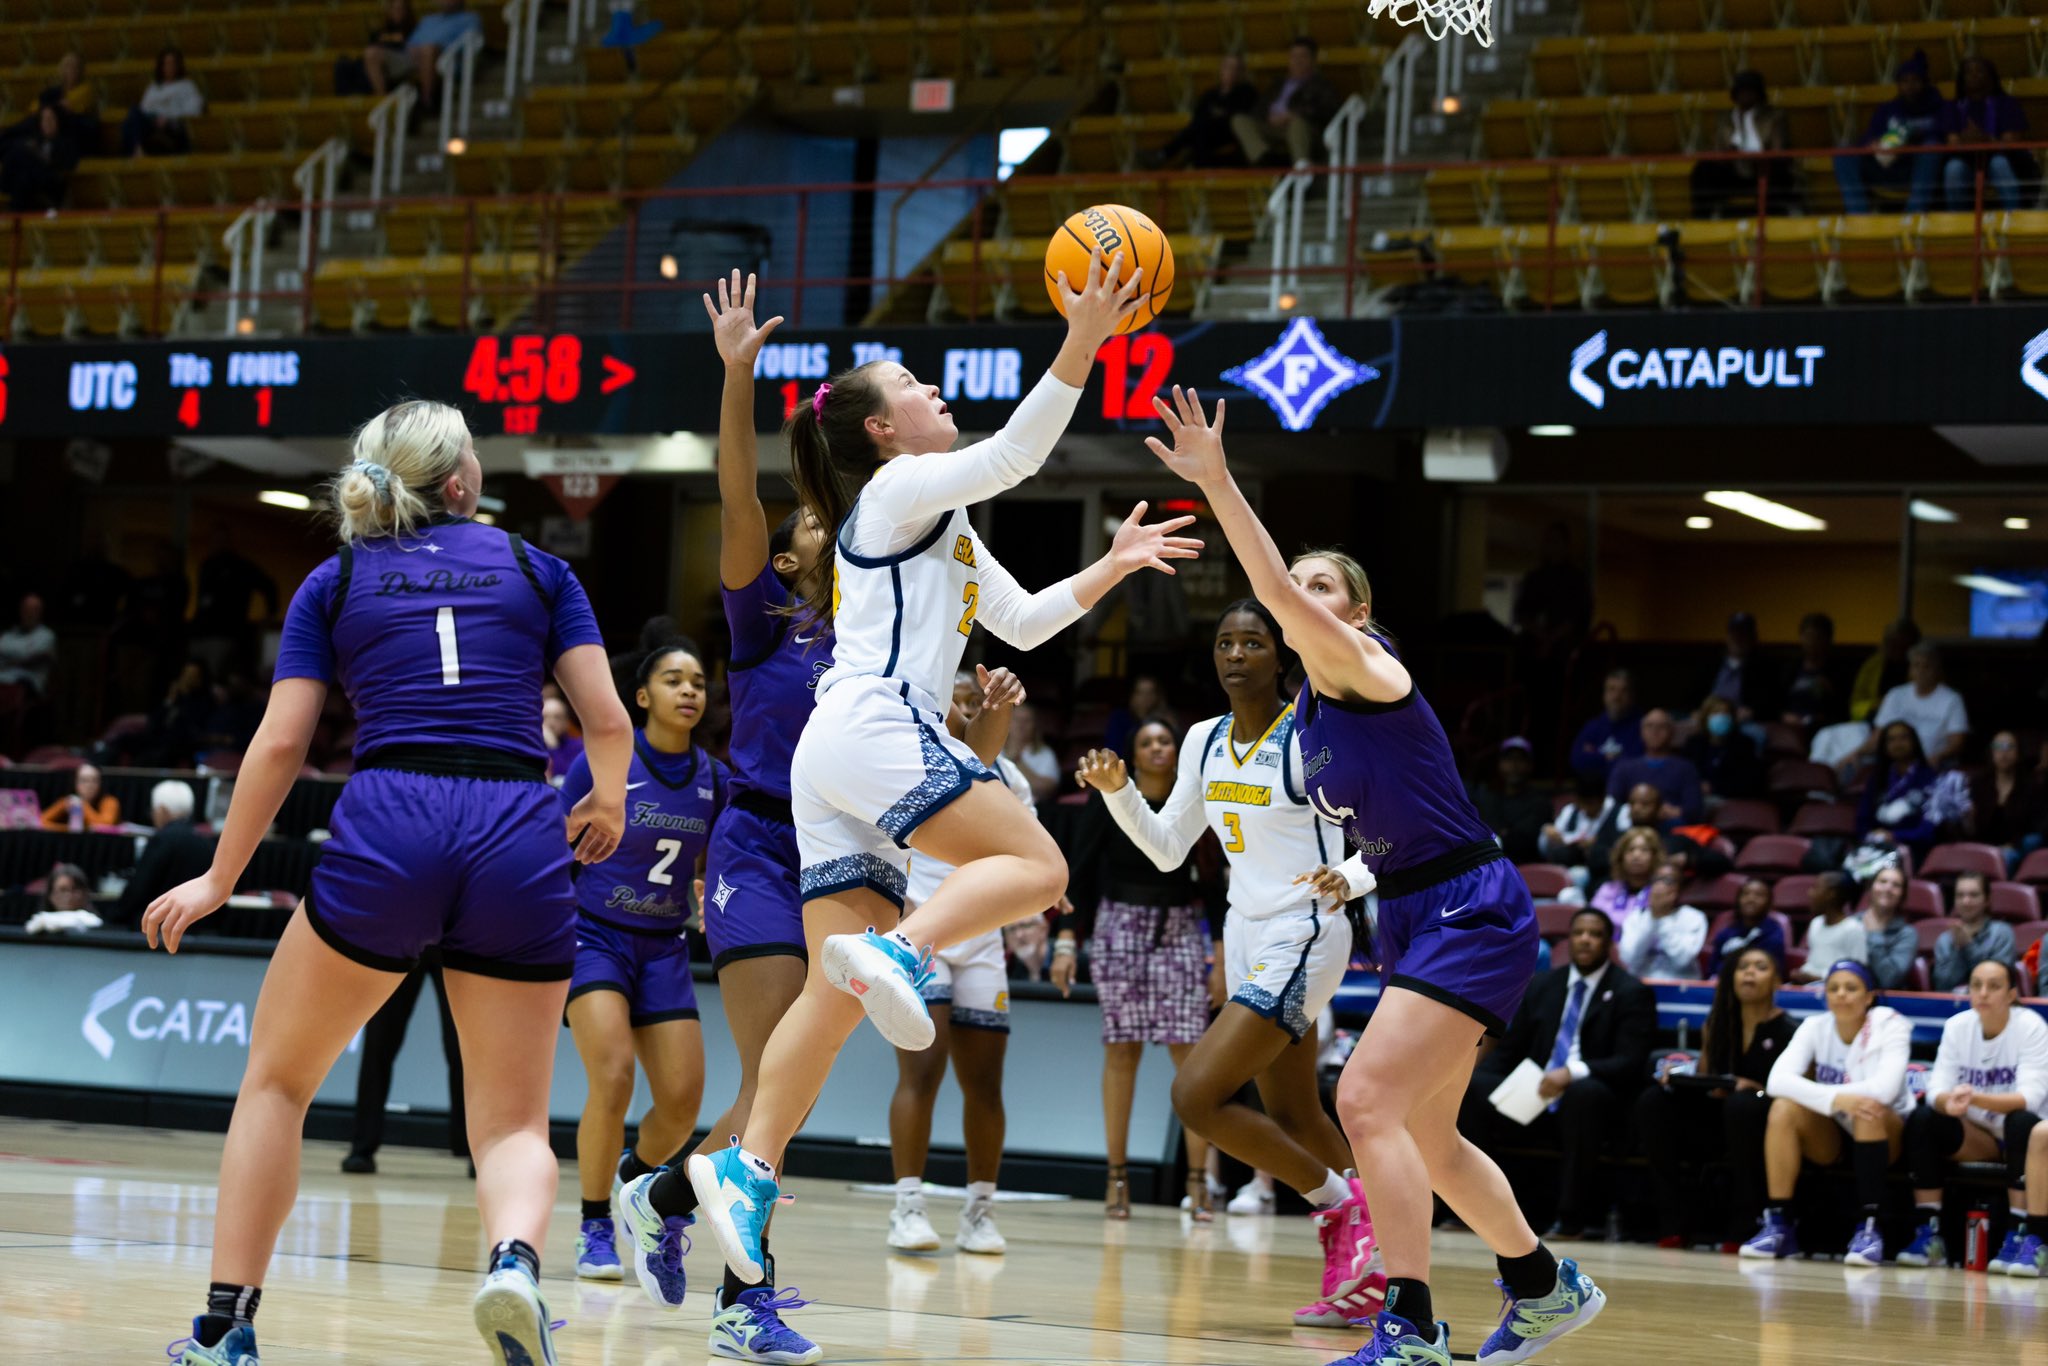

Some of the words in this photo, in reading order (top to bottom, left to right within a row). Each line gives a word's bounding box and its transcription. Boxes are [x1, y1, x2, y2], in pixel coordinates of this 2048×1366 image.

[1082, 208, 1122, 255] Wilso
[69, 361, 137, 409] UTC
[227, 351, 298, 386] FOULS
[463, 334, 582, 403] 4:58
[943, 348, 1021, 399] FUR
[1096, 332, 1174, 419] 12
[1282, 354, 1318, 396] F
[1608, 346, 1824, 389] CATAPULT
[178, 388, 200, 428] 4
[256, 386, 272, 427] 1
[781, 381, 799, 421] 1
[435, 605, 461, 686] 1
[629, 800, 706, 835] Furman
[1223, 811, 1245, 853] 3
[647, 837, 682, 886] 2
[127, 997, 251, 1047] CATA
